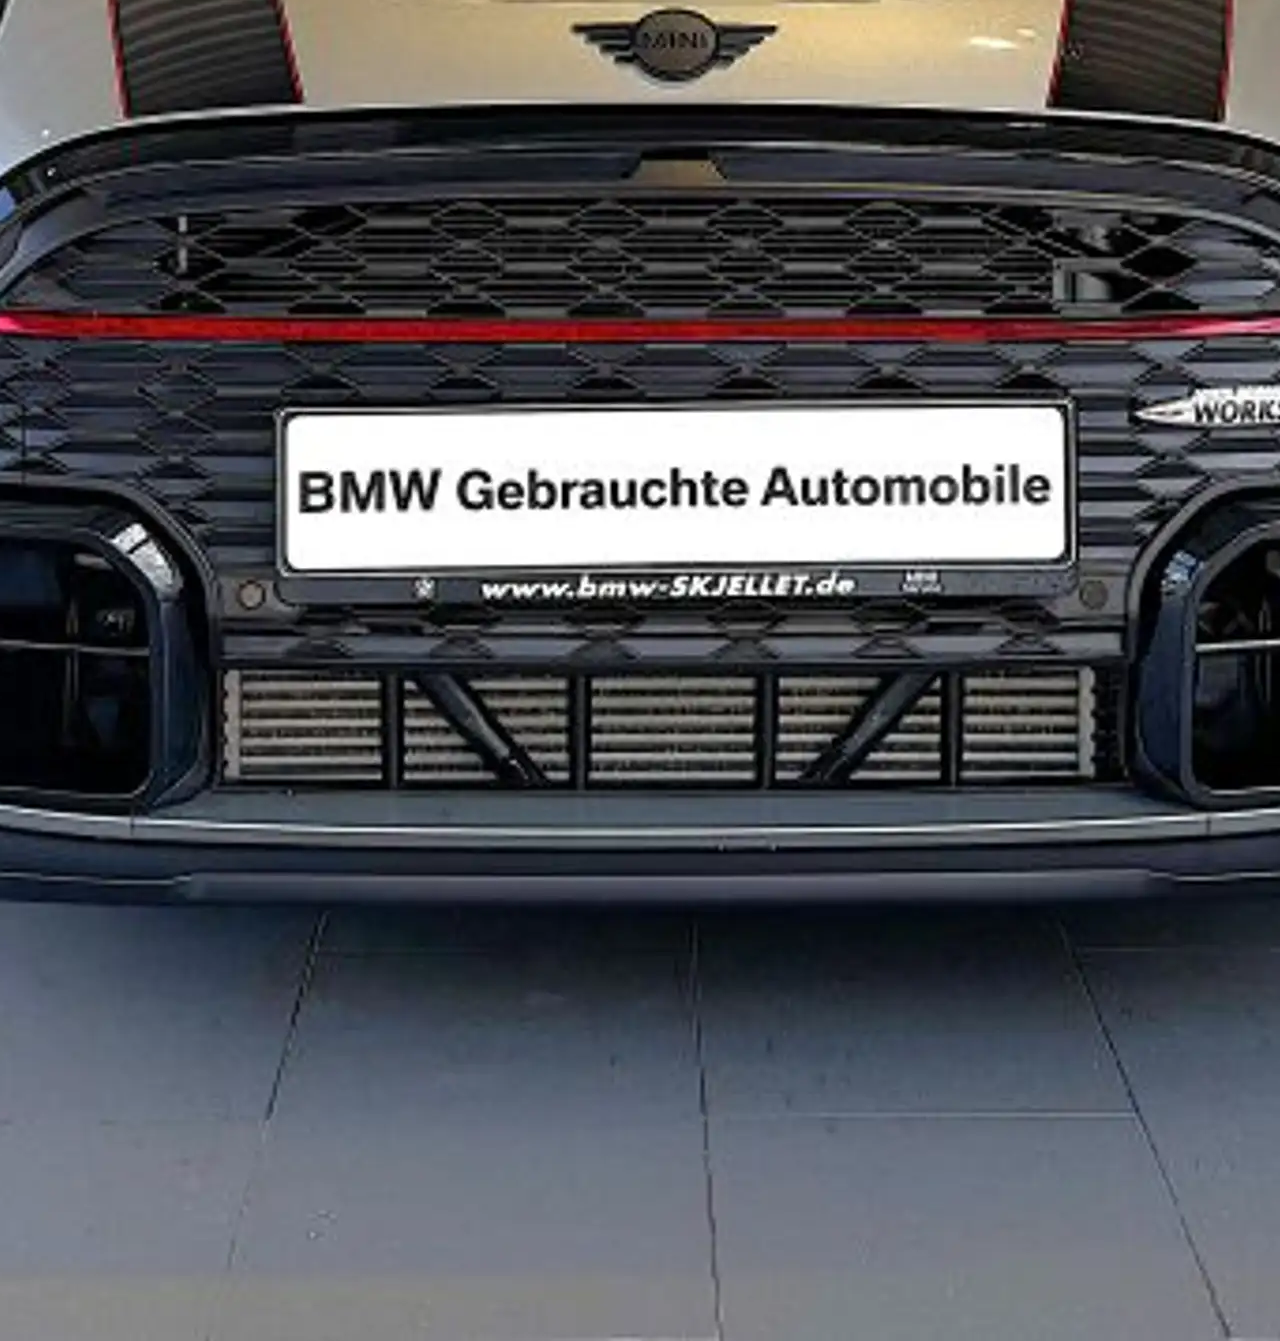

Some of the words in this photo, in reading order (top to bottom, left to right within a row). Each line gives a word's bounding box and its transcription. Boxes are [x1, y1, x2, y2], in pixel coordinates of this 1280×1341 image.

[642, 32, 708, 49] MINI
[299, 470, 442, 514] BMW
[456, 468, 749, 511] Gebrauchte
[760, 464, 1051, 507] Automobile
[481, 571, 855, 600] www.bmw-SKJELLET.de
